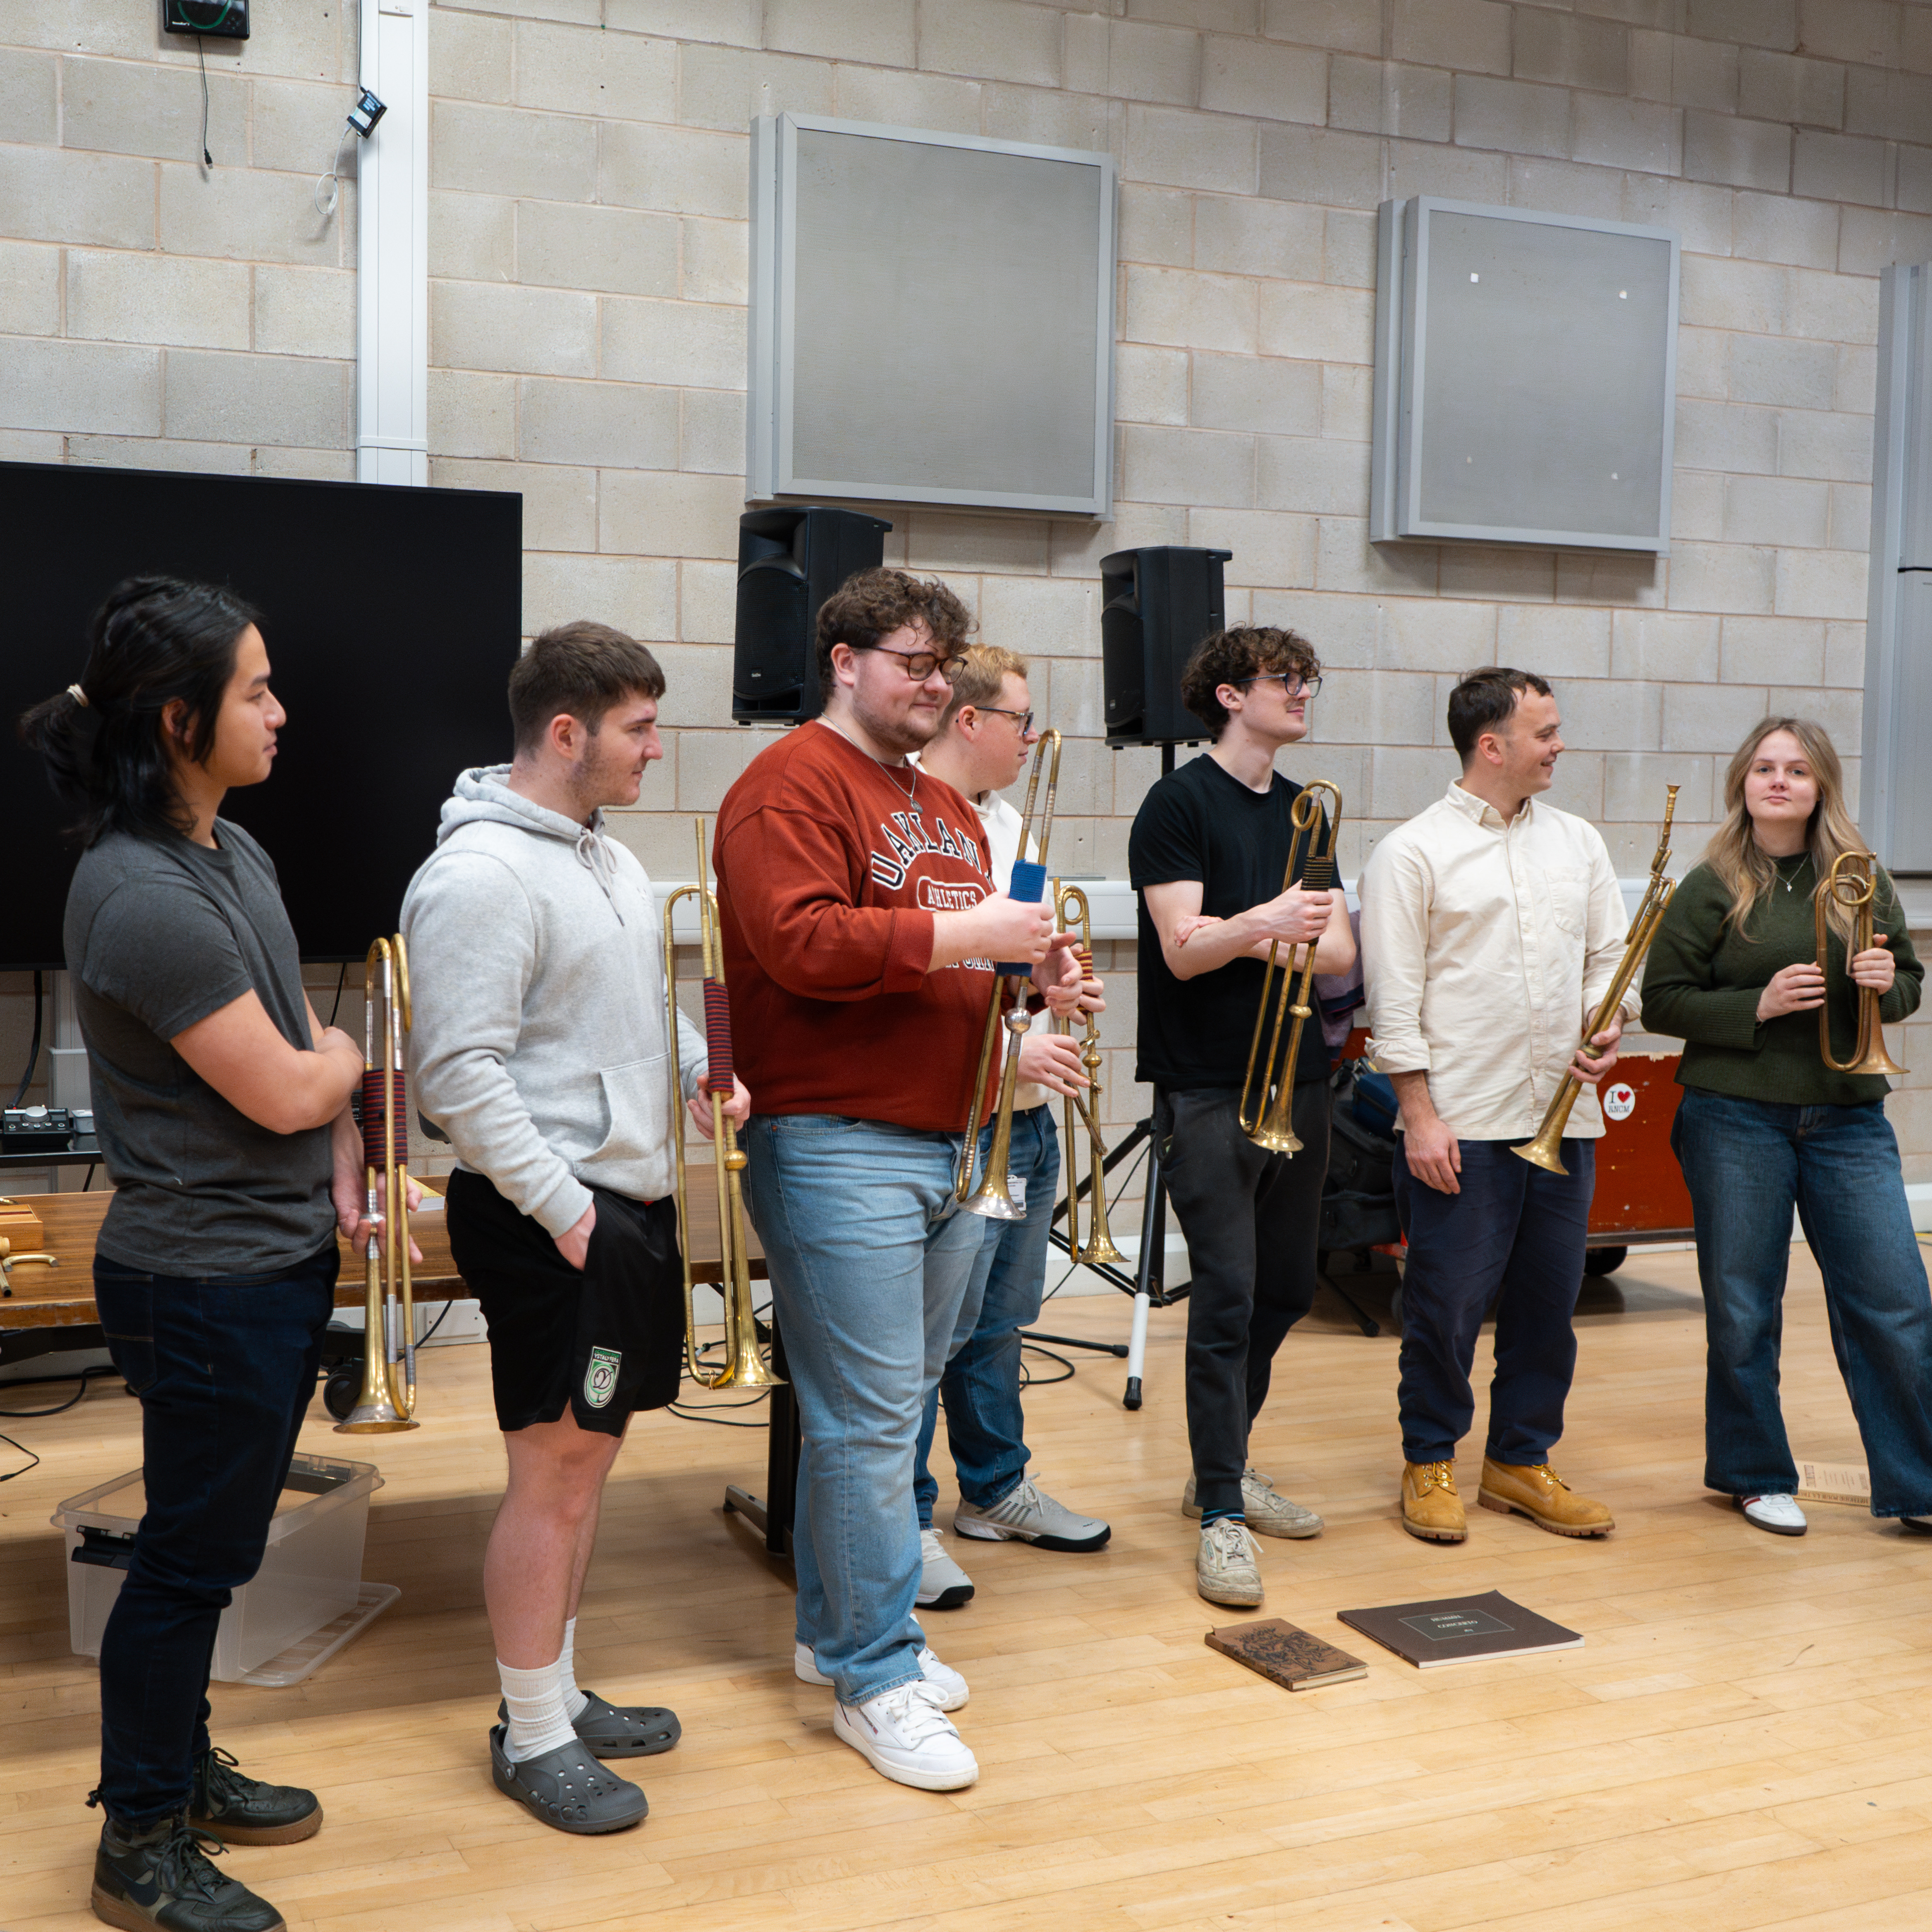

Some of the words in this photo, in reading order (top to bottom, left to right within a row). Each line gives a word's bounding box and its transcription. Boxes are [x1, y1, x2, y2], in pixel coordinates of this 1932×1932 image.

[871, 811, 994, 892] OAKLAN
[928, 885, 977, 910] AHLETICS
[1609, 1091, 1616, 1103] I
[1608, 1105, 1630, 1113] RNCM
